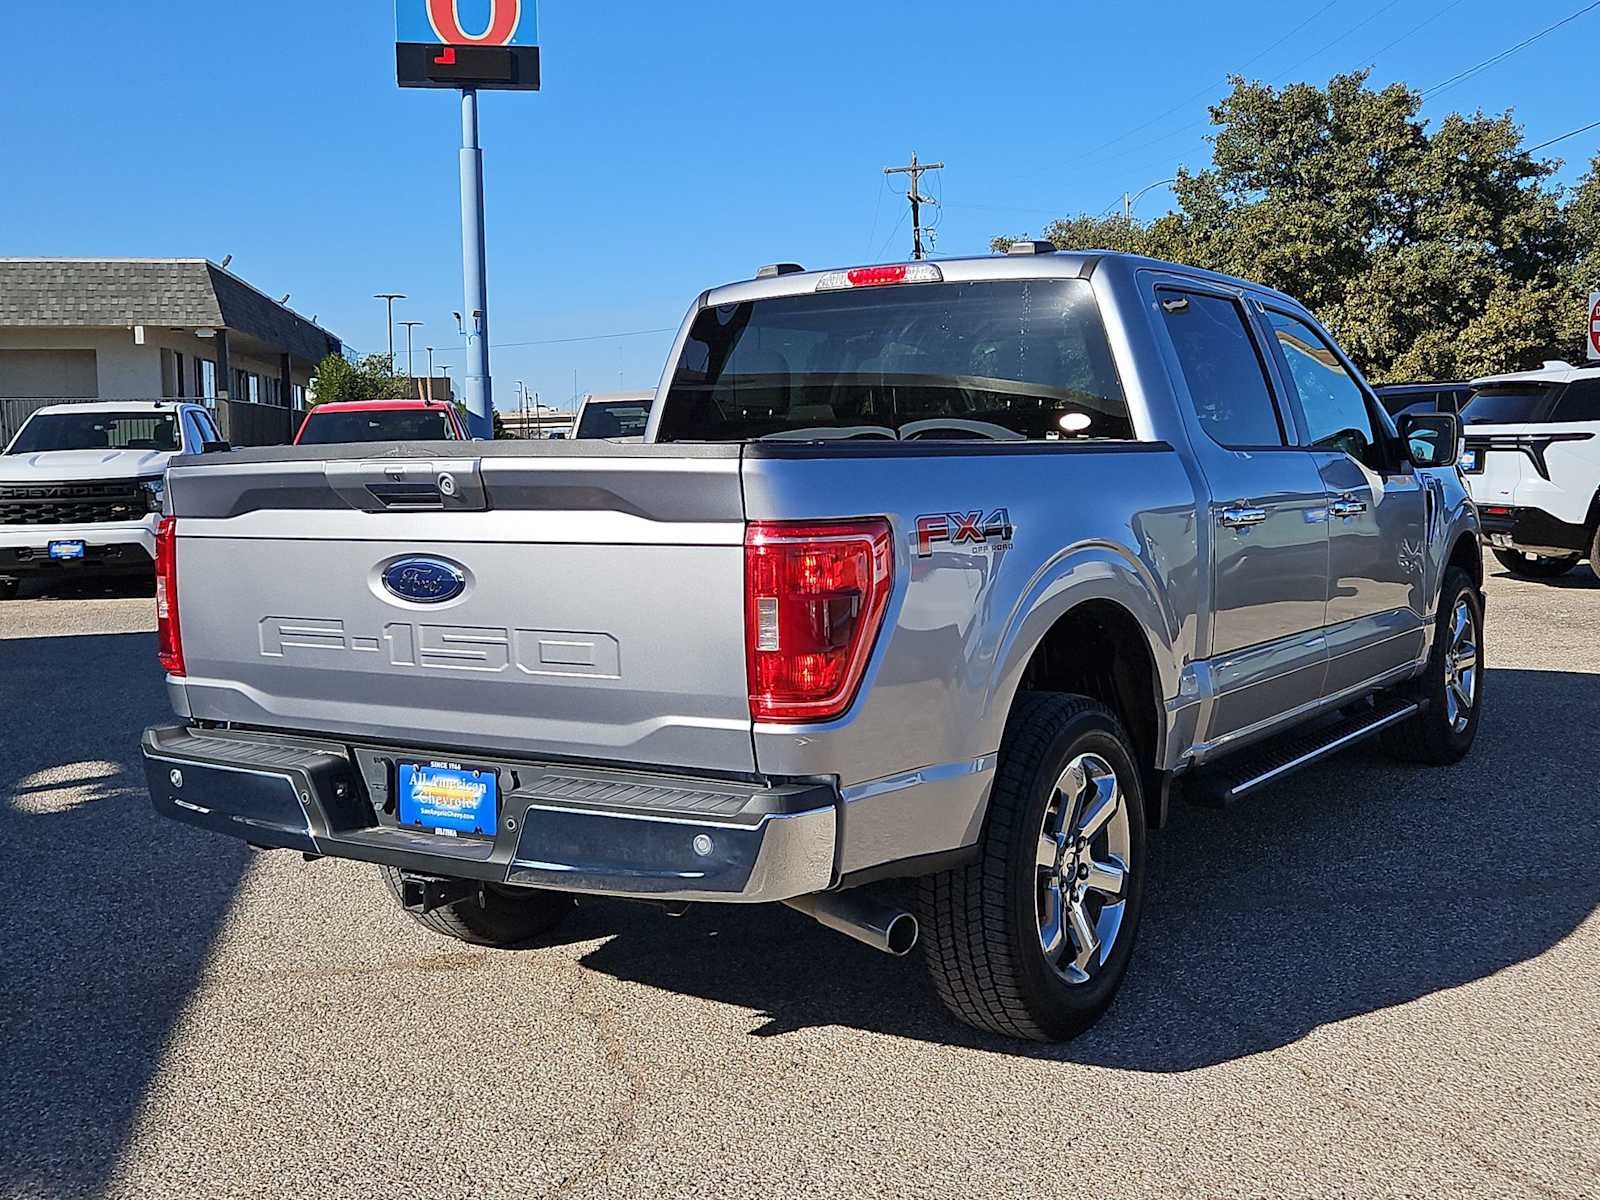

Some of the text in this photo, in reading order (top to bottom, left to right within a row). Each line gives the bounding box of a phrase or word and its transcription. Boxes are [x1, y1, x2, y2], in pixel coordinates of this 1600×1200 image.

[915, 508, 1012, 558] FX4
[259, 615, 621, 679] F-150
[430, 761, 448, 769] SINCE
[409, 772, 487, 793] All American
[419, 790, 478, 810] Chevrolet
